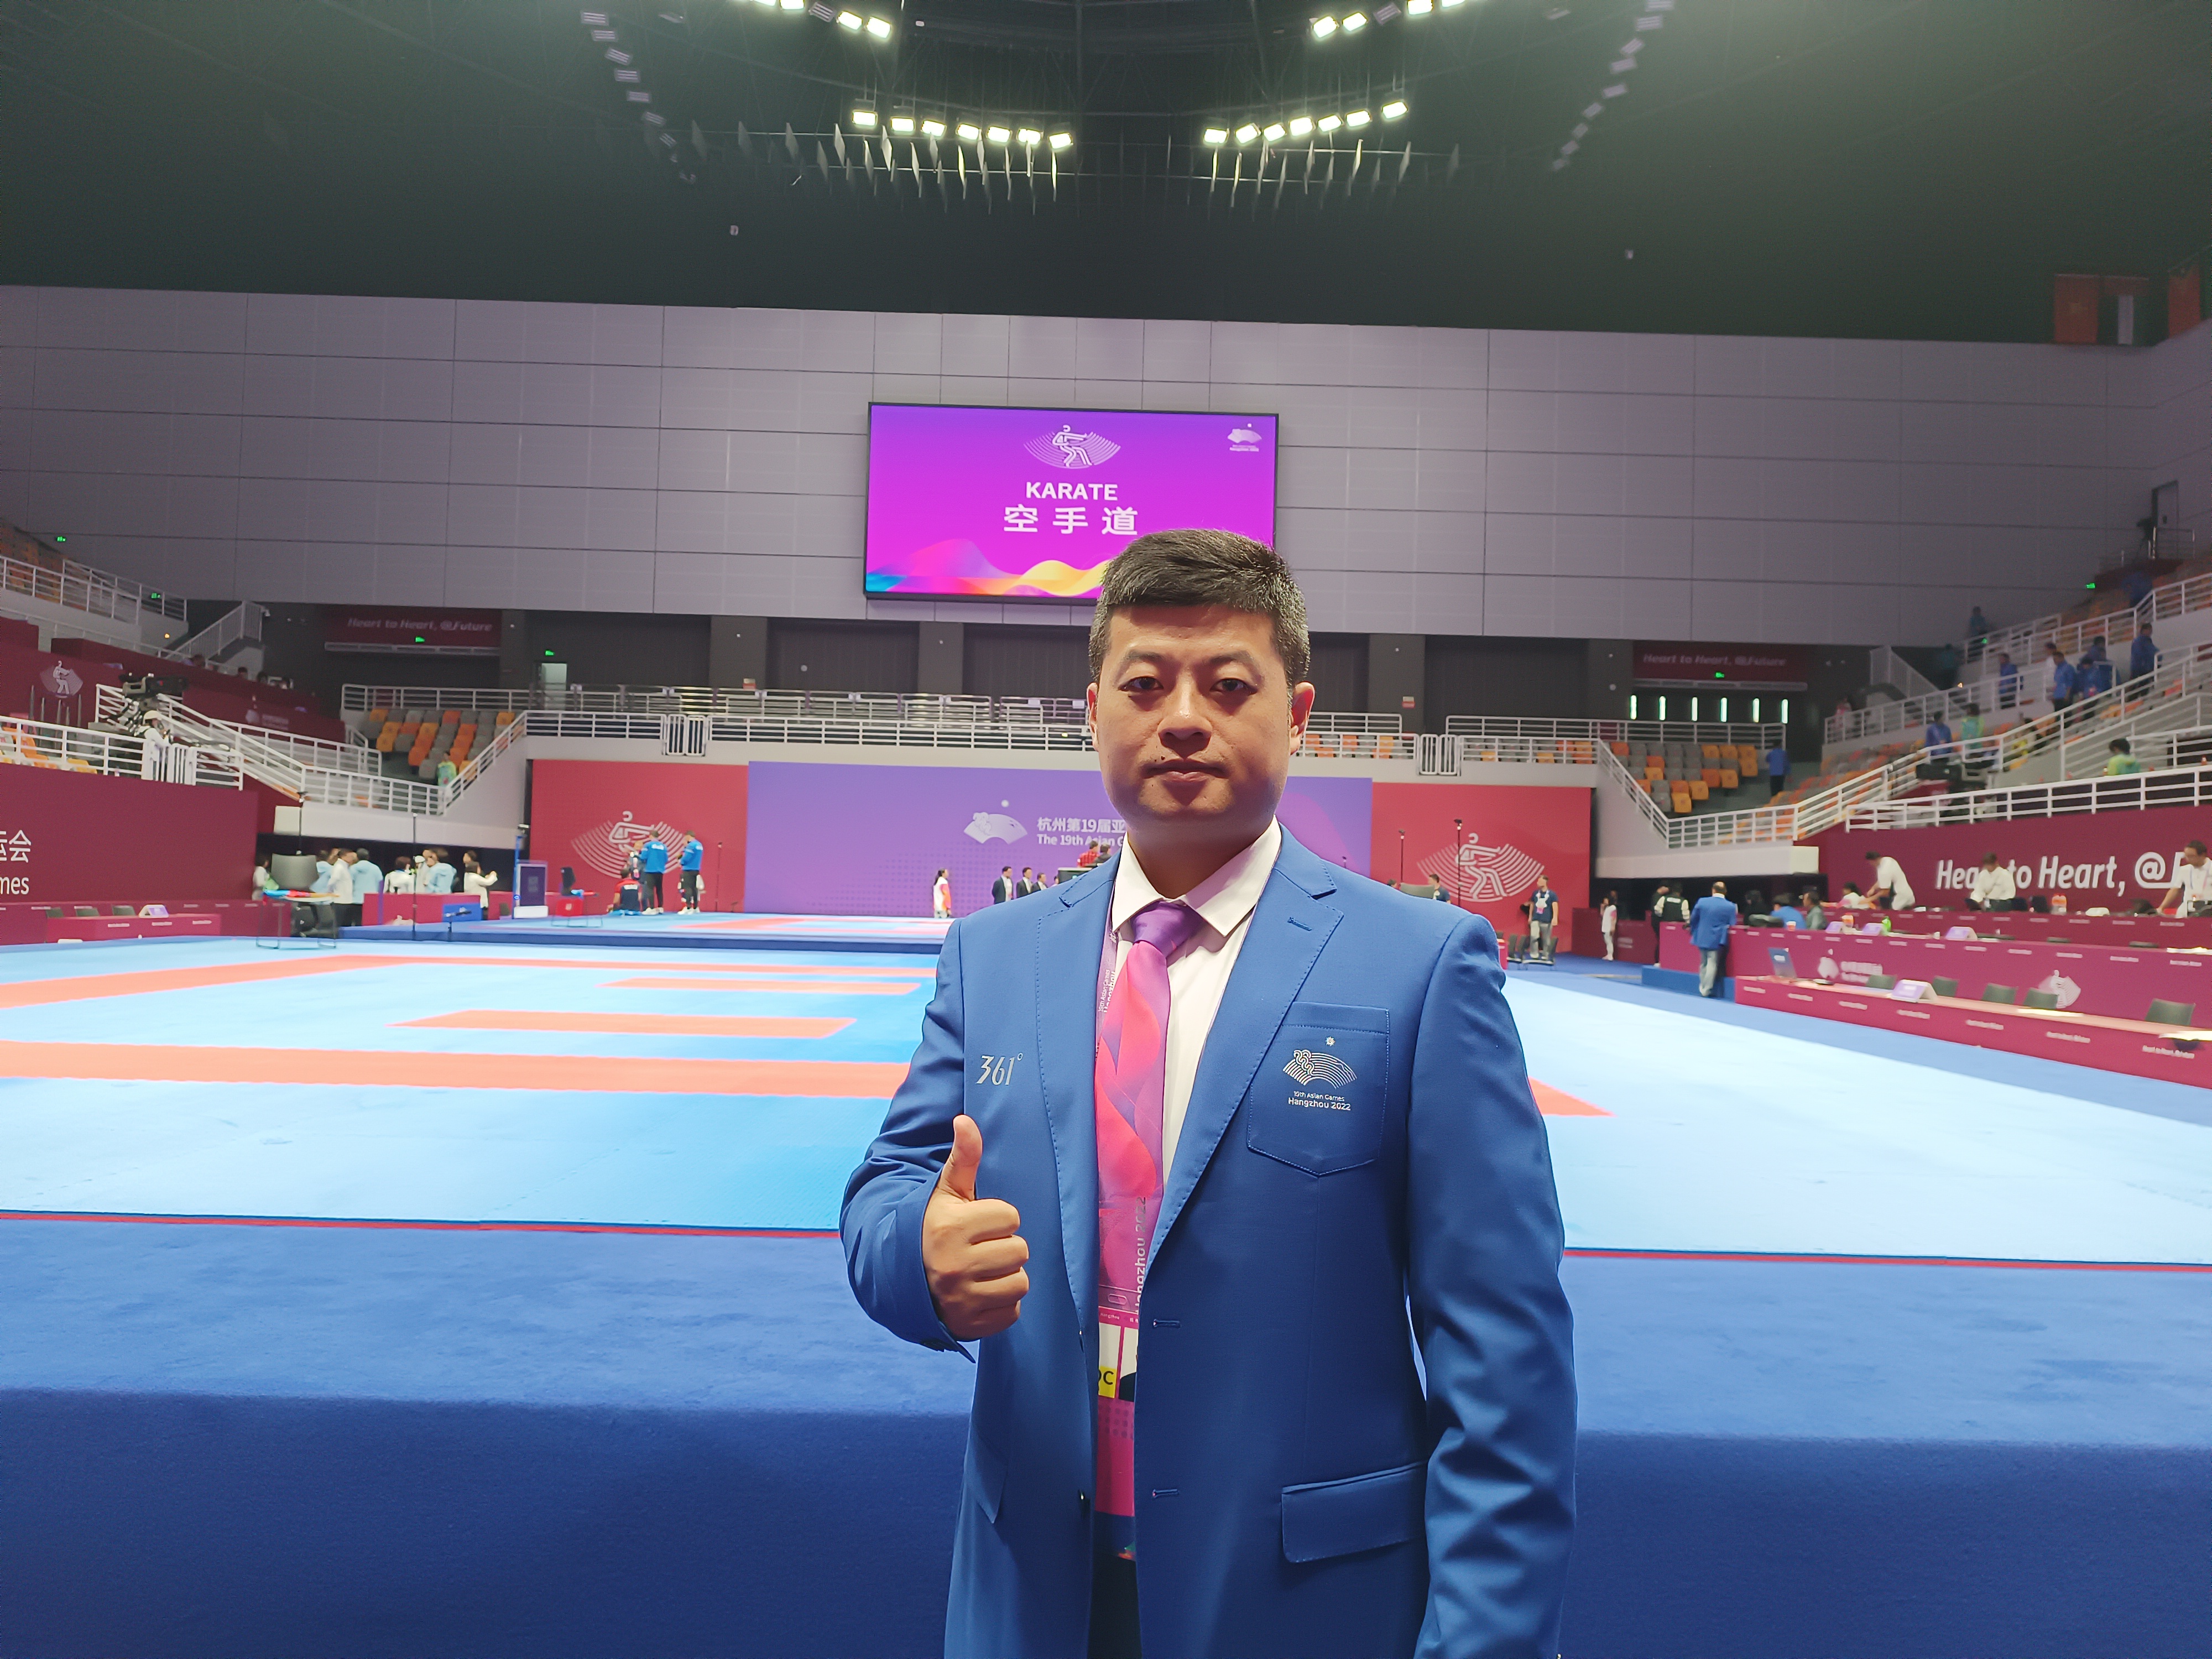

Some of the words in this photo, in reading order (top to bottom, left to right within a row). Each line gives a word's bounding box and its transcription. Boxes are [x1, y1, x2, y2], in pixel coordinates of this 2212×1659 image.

[1025, 481, 1118, 501] KARATE
[1004, 504, 1138, 535] 空手道
[1037, 833, 1057, 846] The
[1060, 834, 1083, 846] 19th
[1936, 859, 1981, 890] Hea
[2038, 855, 2126, 897] Heart,
[1288, 1097, 1329, 1108] Hangzhou
[1331, 1102, 1351, 1111] 2022
[1135, 1196, 1146, 1233] 2022
